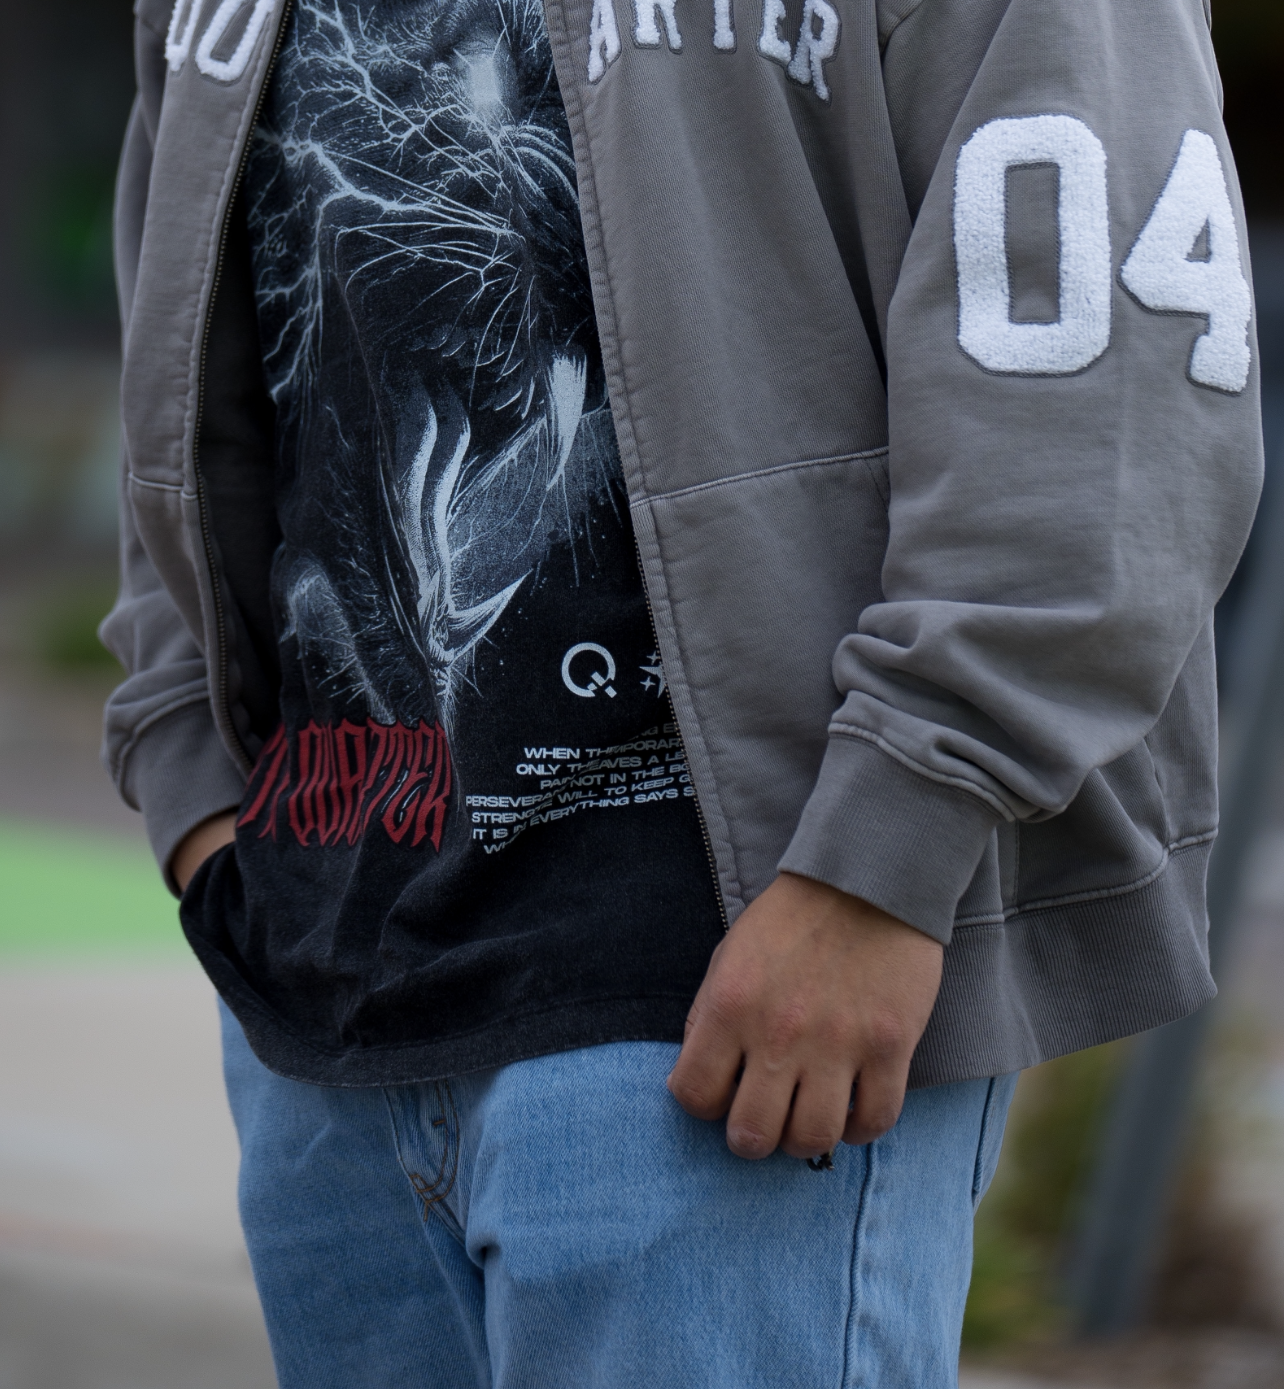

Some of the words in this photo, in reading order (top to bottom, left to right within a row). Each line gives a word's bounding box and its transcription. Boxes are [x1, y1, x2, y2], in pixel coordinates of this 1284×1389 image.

[954, 114, 1251, 393] 04
[524, 747, 580, 759] WHEN
[516, 763, 561, 775] ONLY
[647, 755, 660, 766] A
[609, 773, 627, 784] IN
[631, 766, 665, 780] THE
[557, 791, 598, 804] WILL
[604, 786, 627, 796] TO
[631, 777, 675, 792] KEEP
[472, 828, 487, 840] IT
[492, 828, 509, 840] IS
[529, 796, 630, 827] EVERYTHING
[634, 788, 679, 804] SAYS
